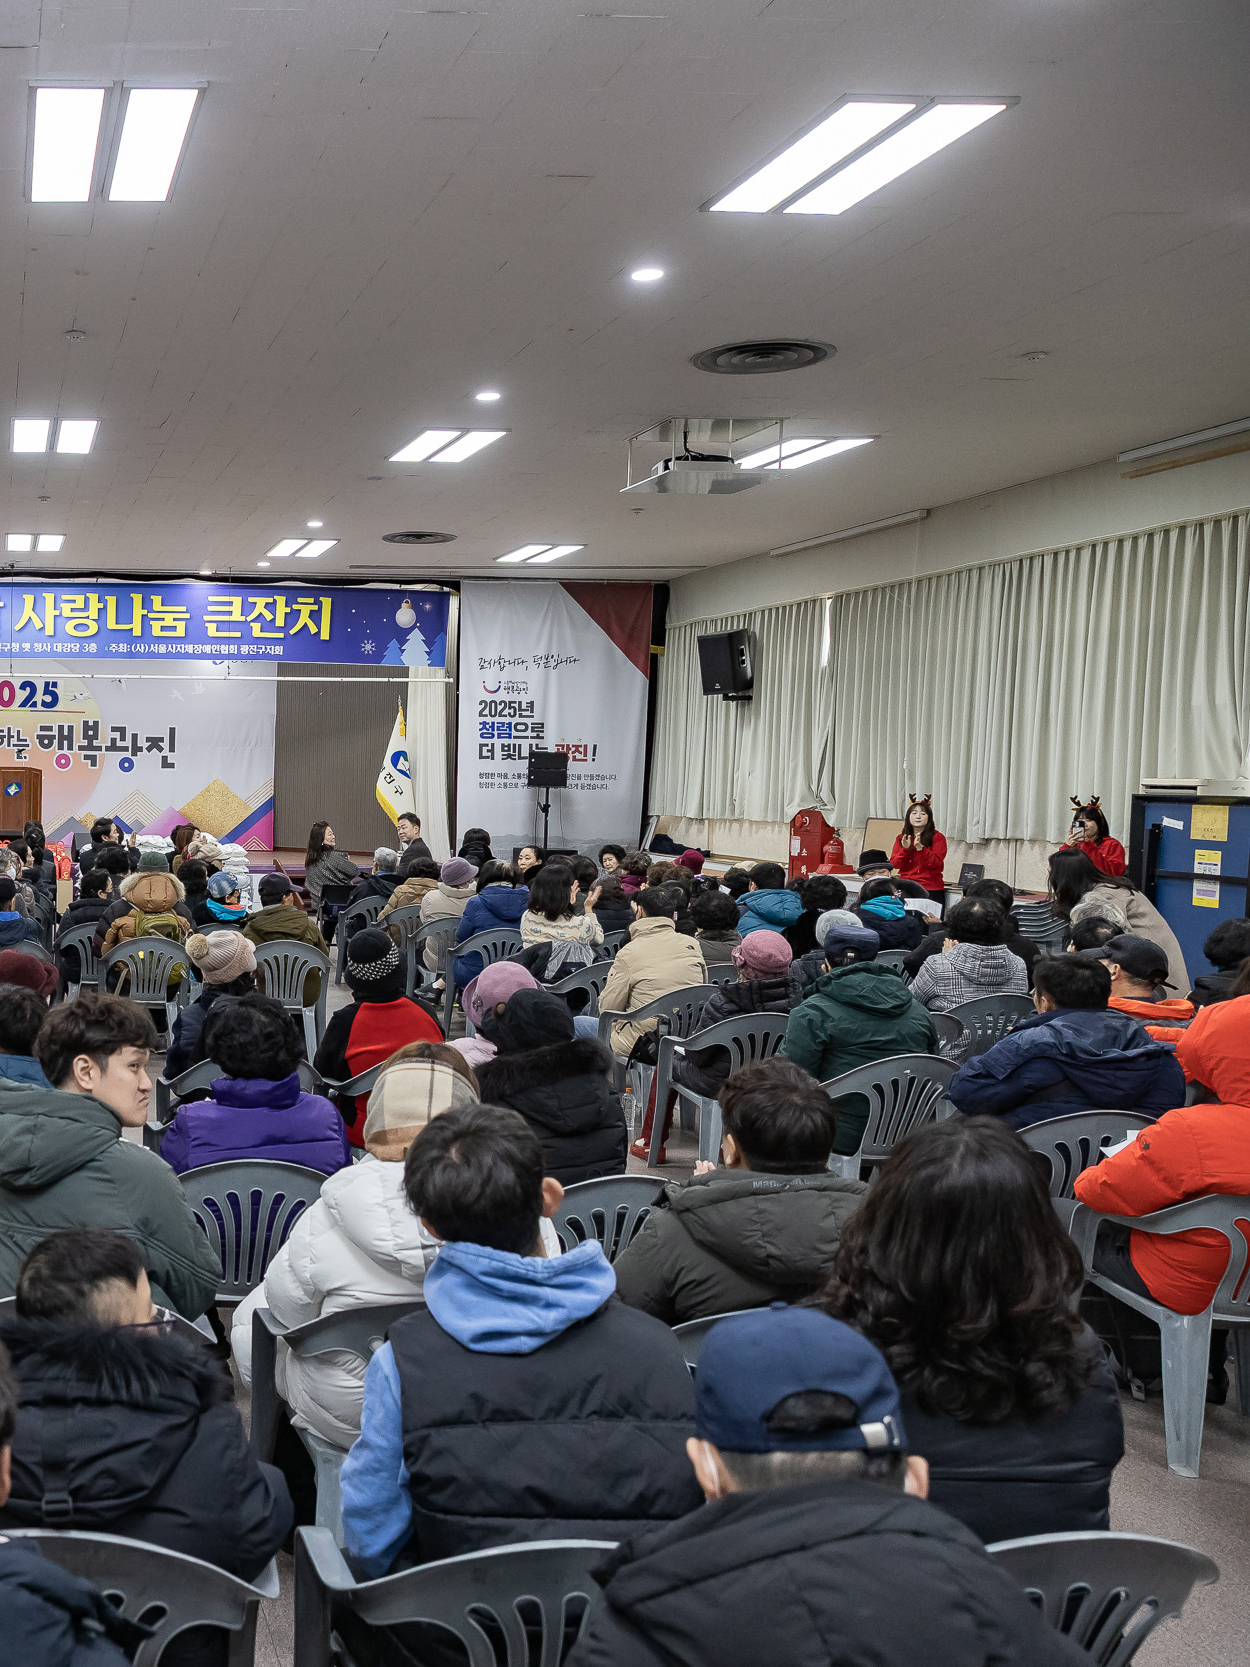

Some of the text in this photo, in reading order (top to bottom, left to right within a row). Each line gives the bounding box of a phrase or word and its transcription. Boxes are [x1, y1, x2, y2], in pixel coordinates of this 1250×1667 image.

[14, 592, 190, 637] 사랑나눔
[203, 595, 332, 640] 큰잔치
[33, 643, 51, 653] 청사
[53, 643, 80, 653] 대강당
[82, 643, 98, 653] 3층
[239, 644, 283, 655] 광진구지회
[478, 655, 528, 671] 감사합니다,
[478, 699, 534, 719] 2025년
[478, 720, 545, 740] 청렴으로
[478, 742, 495, 761] 더
